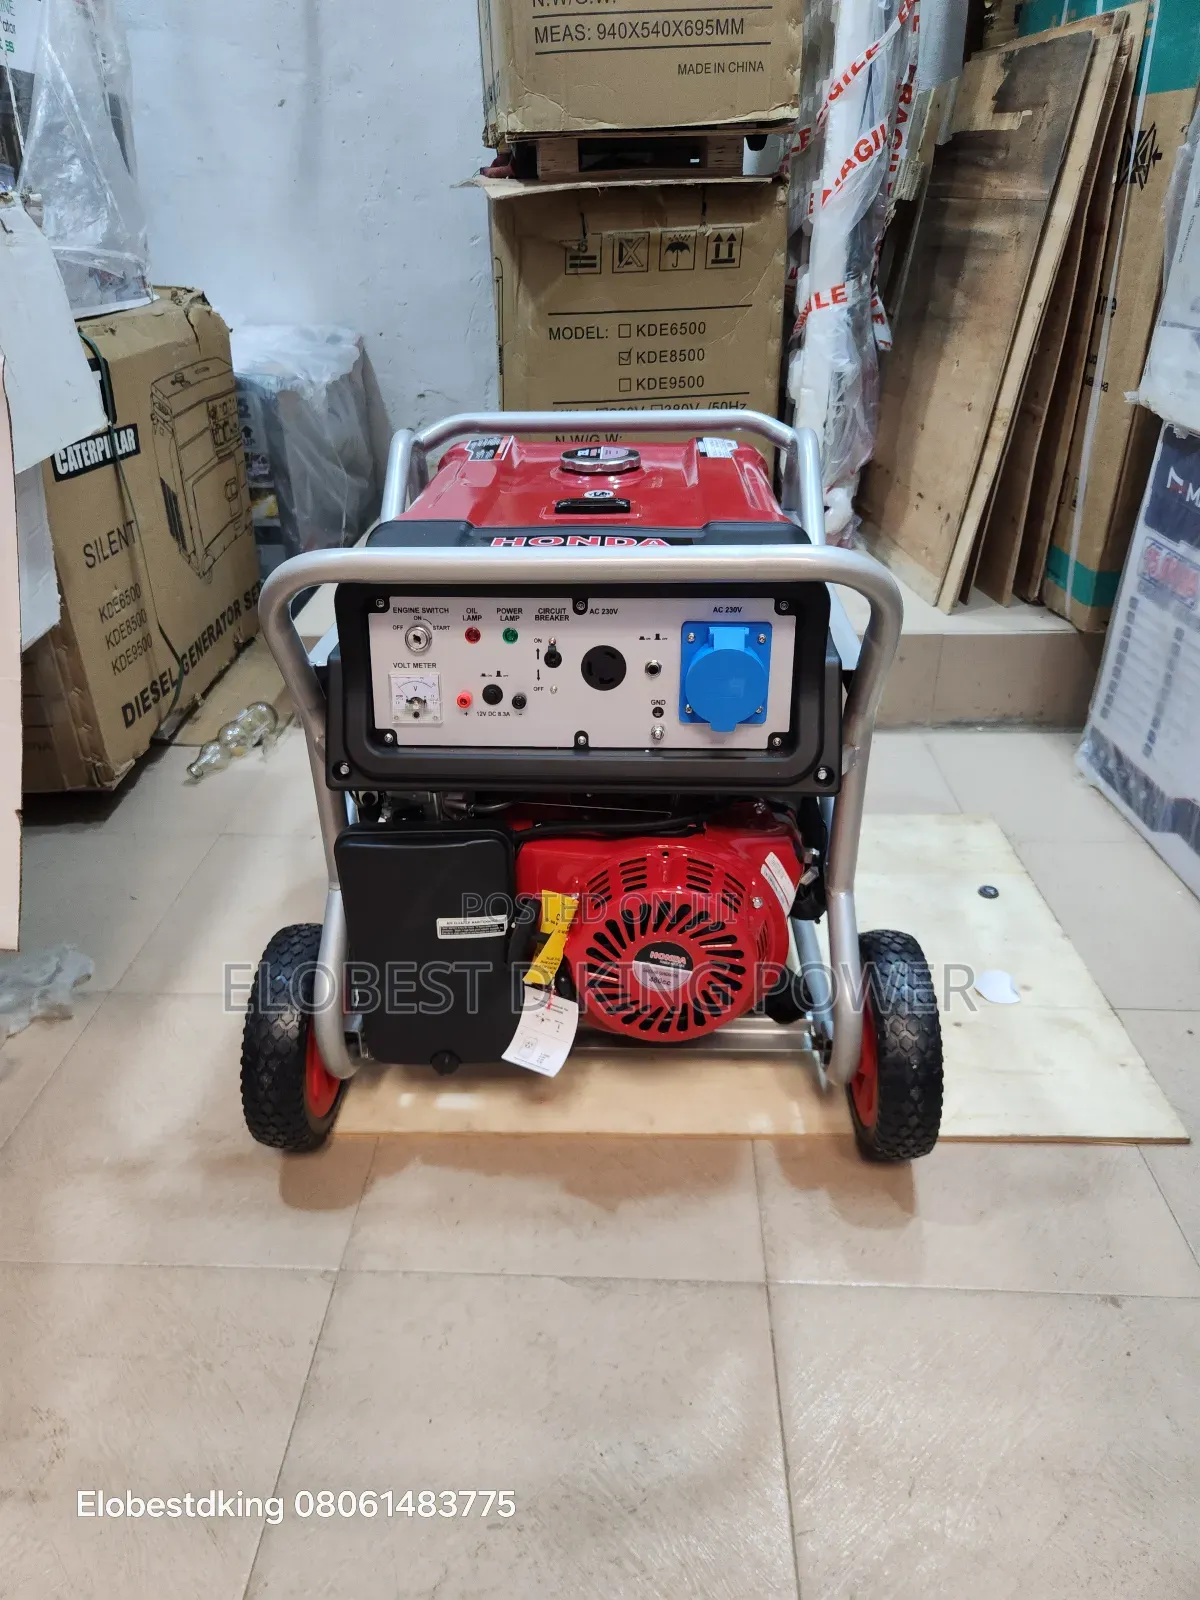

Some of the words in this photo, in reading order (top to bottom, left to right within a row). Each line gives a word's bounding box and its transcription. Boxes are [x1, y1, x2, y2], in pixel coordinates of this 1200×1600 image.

[534, 24, 591, 44] MEAS:
[597, 17, 745, 41] 940X540X695MM
[677, 62, 712, 76] MADE
[713, 62, 726, 75] IN
[727, 60, 765, 74] CHINA
[548, 326, 609, 341] MODEL:
[636, 321, 707, 338] KDE6500
[636, 348, 706, 364] KDE8500
[636, 375, 705, 391] KDE9500
[53, 427, 137, 476] CATERPILAR
[82, 519, 137, 569] SILENT
[489, 535, 672, 548] HONDA
[98, 582, 142, 624] KDE6500
[712, 606, 724, 614] AC
[725, 606, 743, 614] 230V
[392, 607, 420, 615] ENGINE
[421, 607, 450, 615] SWITCH
[462, 614, 483, 622] LAMP
[465, 607, 478, 615] OIL
[496, 607, 523, 615] POWER
[499, 614, 521, 622] LAMP
[534, 614, 570, 622] BREAKER
[537, 607, 567, 615] CIRCUIT
[589, 607, 600, 615] AC
[601, 607, 619, 615] 230V
[105, 608, 148, 650] KDE8500
[111, 633, 153, 676] KDE9500
[121, 666, 179, 730] DIESEL
[180, 599, 243, 677] GENERATOR
[243, 579, 263, 612] SE
[649, 951, 687, 965] HONDA
